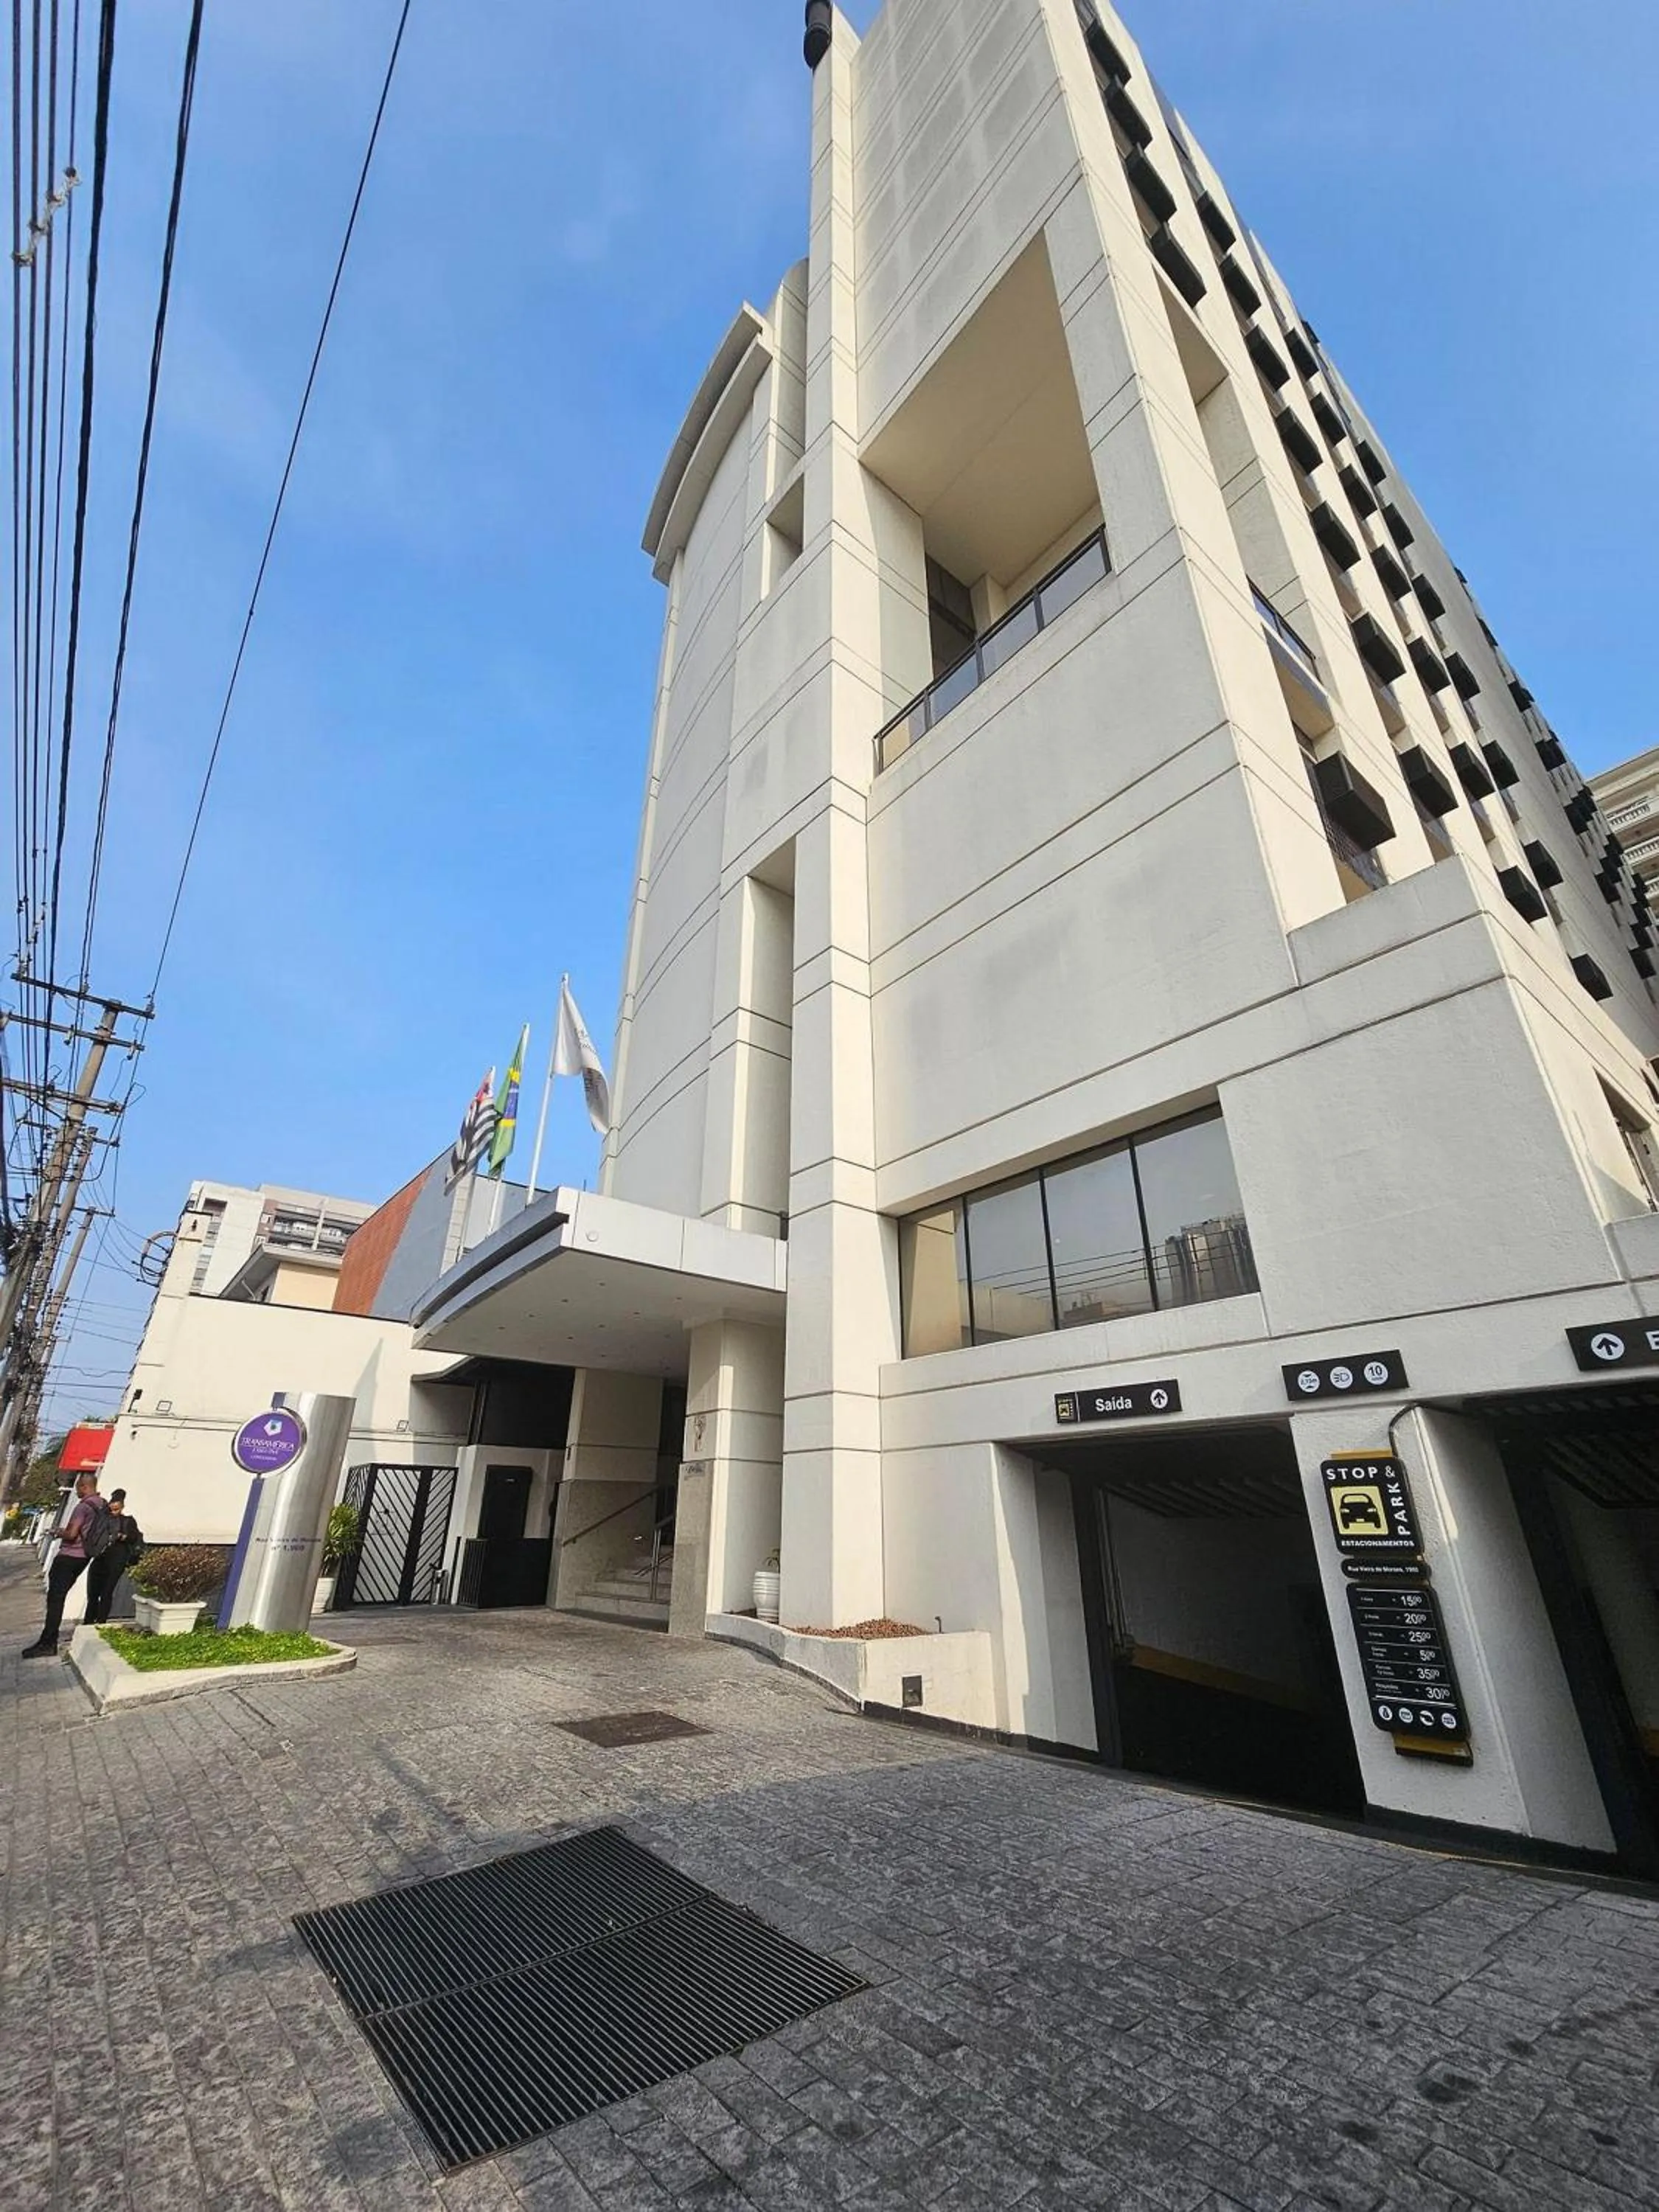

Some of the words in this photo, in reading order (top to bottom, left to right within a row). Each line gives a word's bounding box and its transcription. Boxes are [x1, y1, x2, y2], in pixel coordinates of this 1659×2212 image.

[1368, 1365, 1382, 1377] 10
[1095, 1397, 1133, 1412] Saída
[1326, 1467, 1378, 1480] STOP
[1385, 1465, 1395, 1478] &
[1387, 1482, 1411, 1535] PARK
